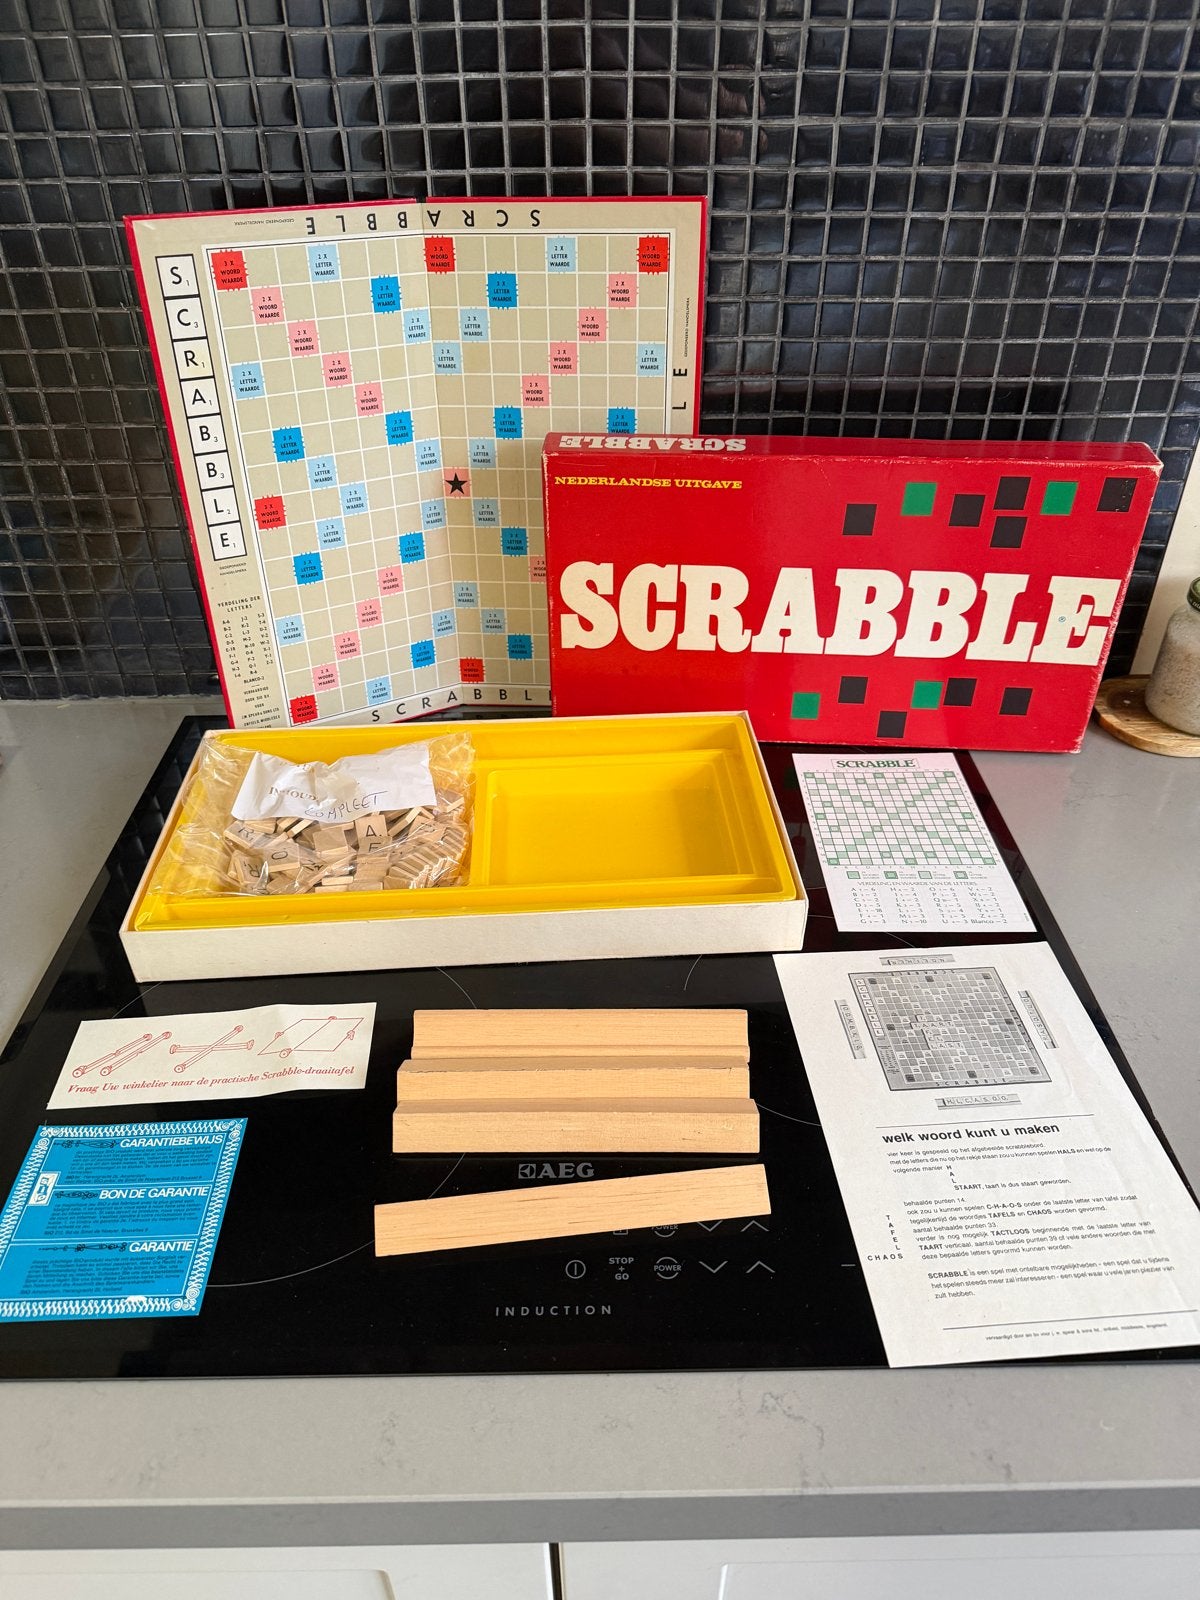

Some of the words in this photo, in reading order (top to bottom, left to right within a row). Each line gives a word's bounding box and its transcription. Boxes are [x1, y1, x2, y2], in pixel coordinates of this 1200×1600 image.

[559, 435, 747, 452] SCRABBLE
[554, 476, 672, 488] NEDERLANDSE
[674, 478, 743, 489] UITGAVE
[560, 560, 1122, 667] SCRABBLE
[836, 759, 916, 768] SCRABBLE
[68, 1084, 99, 1095] Vraag
[102, 1082, 119, 1091] Uw
[122, 1079, 168, 1090] winkelier
[171, 1079, 194, 1087] naar
[196, 1077, 209, 1086] de
[209, 1073, 260, 1087] practische
[882, 1132, 915, 1143] welk
[918, 1129, 962, 1141] woord
[965, 1127, 998, 1138] kunt
[1000, 1129, 1010, 1137] u
[1014, 1124, 1060, 1135] maken
[119, 1134, 224, 1148] GARANTIEBEWIJS
[537, 1162, 595, 1179] AEG
[98, 1189, 128, 1200] BON
[129, 1188, 146, 1199] DE
[147, 1186, 210, 1198] GARANTIE
[1026, 1208, 1052, 1216] CHAOS
[990, 1228, 1030, 1237] TACTLOOS
[128, 1240, 196, 1253] GARANTIE
[918, 1243, 943, 1251] TAART
[608, 1257, 635, 1265] STOP
[653, 1264, 682, 1272] POWER
[927, 1270, 969, 1279] SCRABBLE
[614, 1273, 630, 1281] GO
[495, 1304, 612, 1317] INDUCTION
